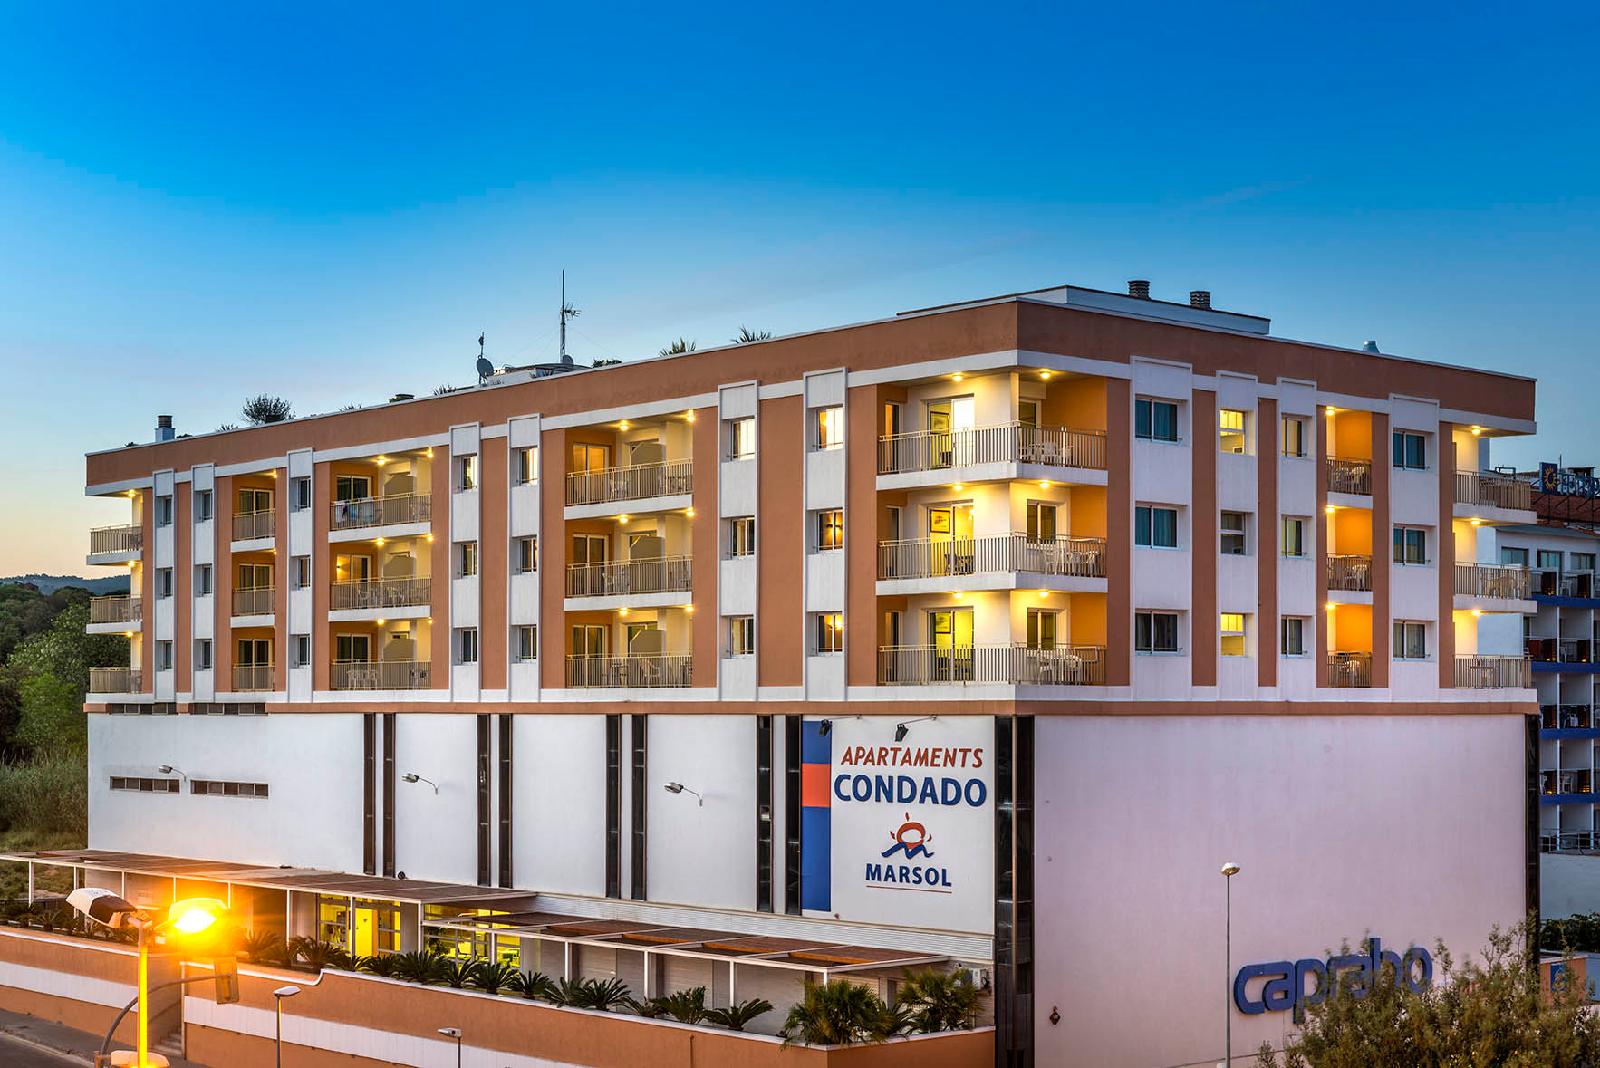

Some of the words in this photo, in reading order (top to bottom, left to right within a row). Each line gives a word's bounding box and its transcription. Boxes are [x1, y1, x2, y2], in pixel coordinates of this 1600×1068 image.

[841, 746, 983, 768] APARTAMENTS
[834, 774, 987, 807] CONDADO
[865, 863, 952, 887] MARSOL
